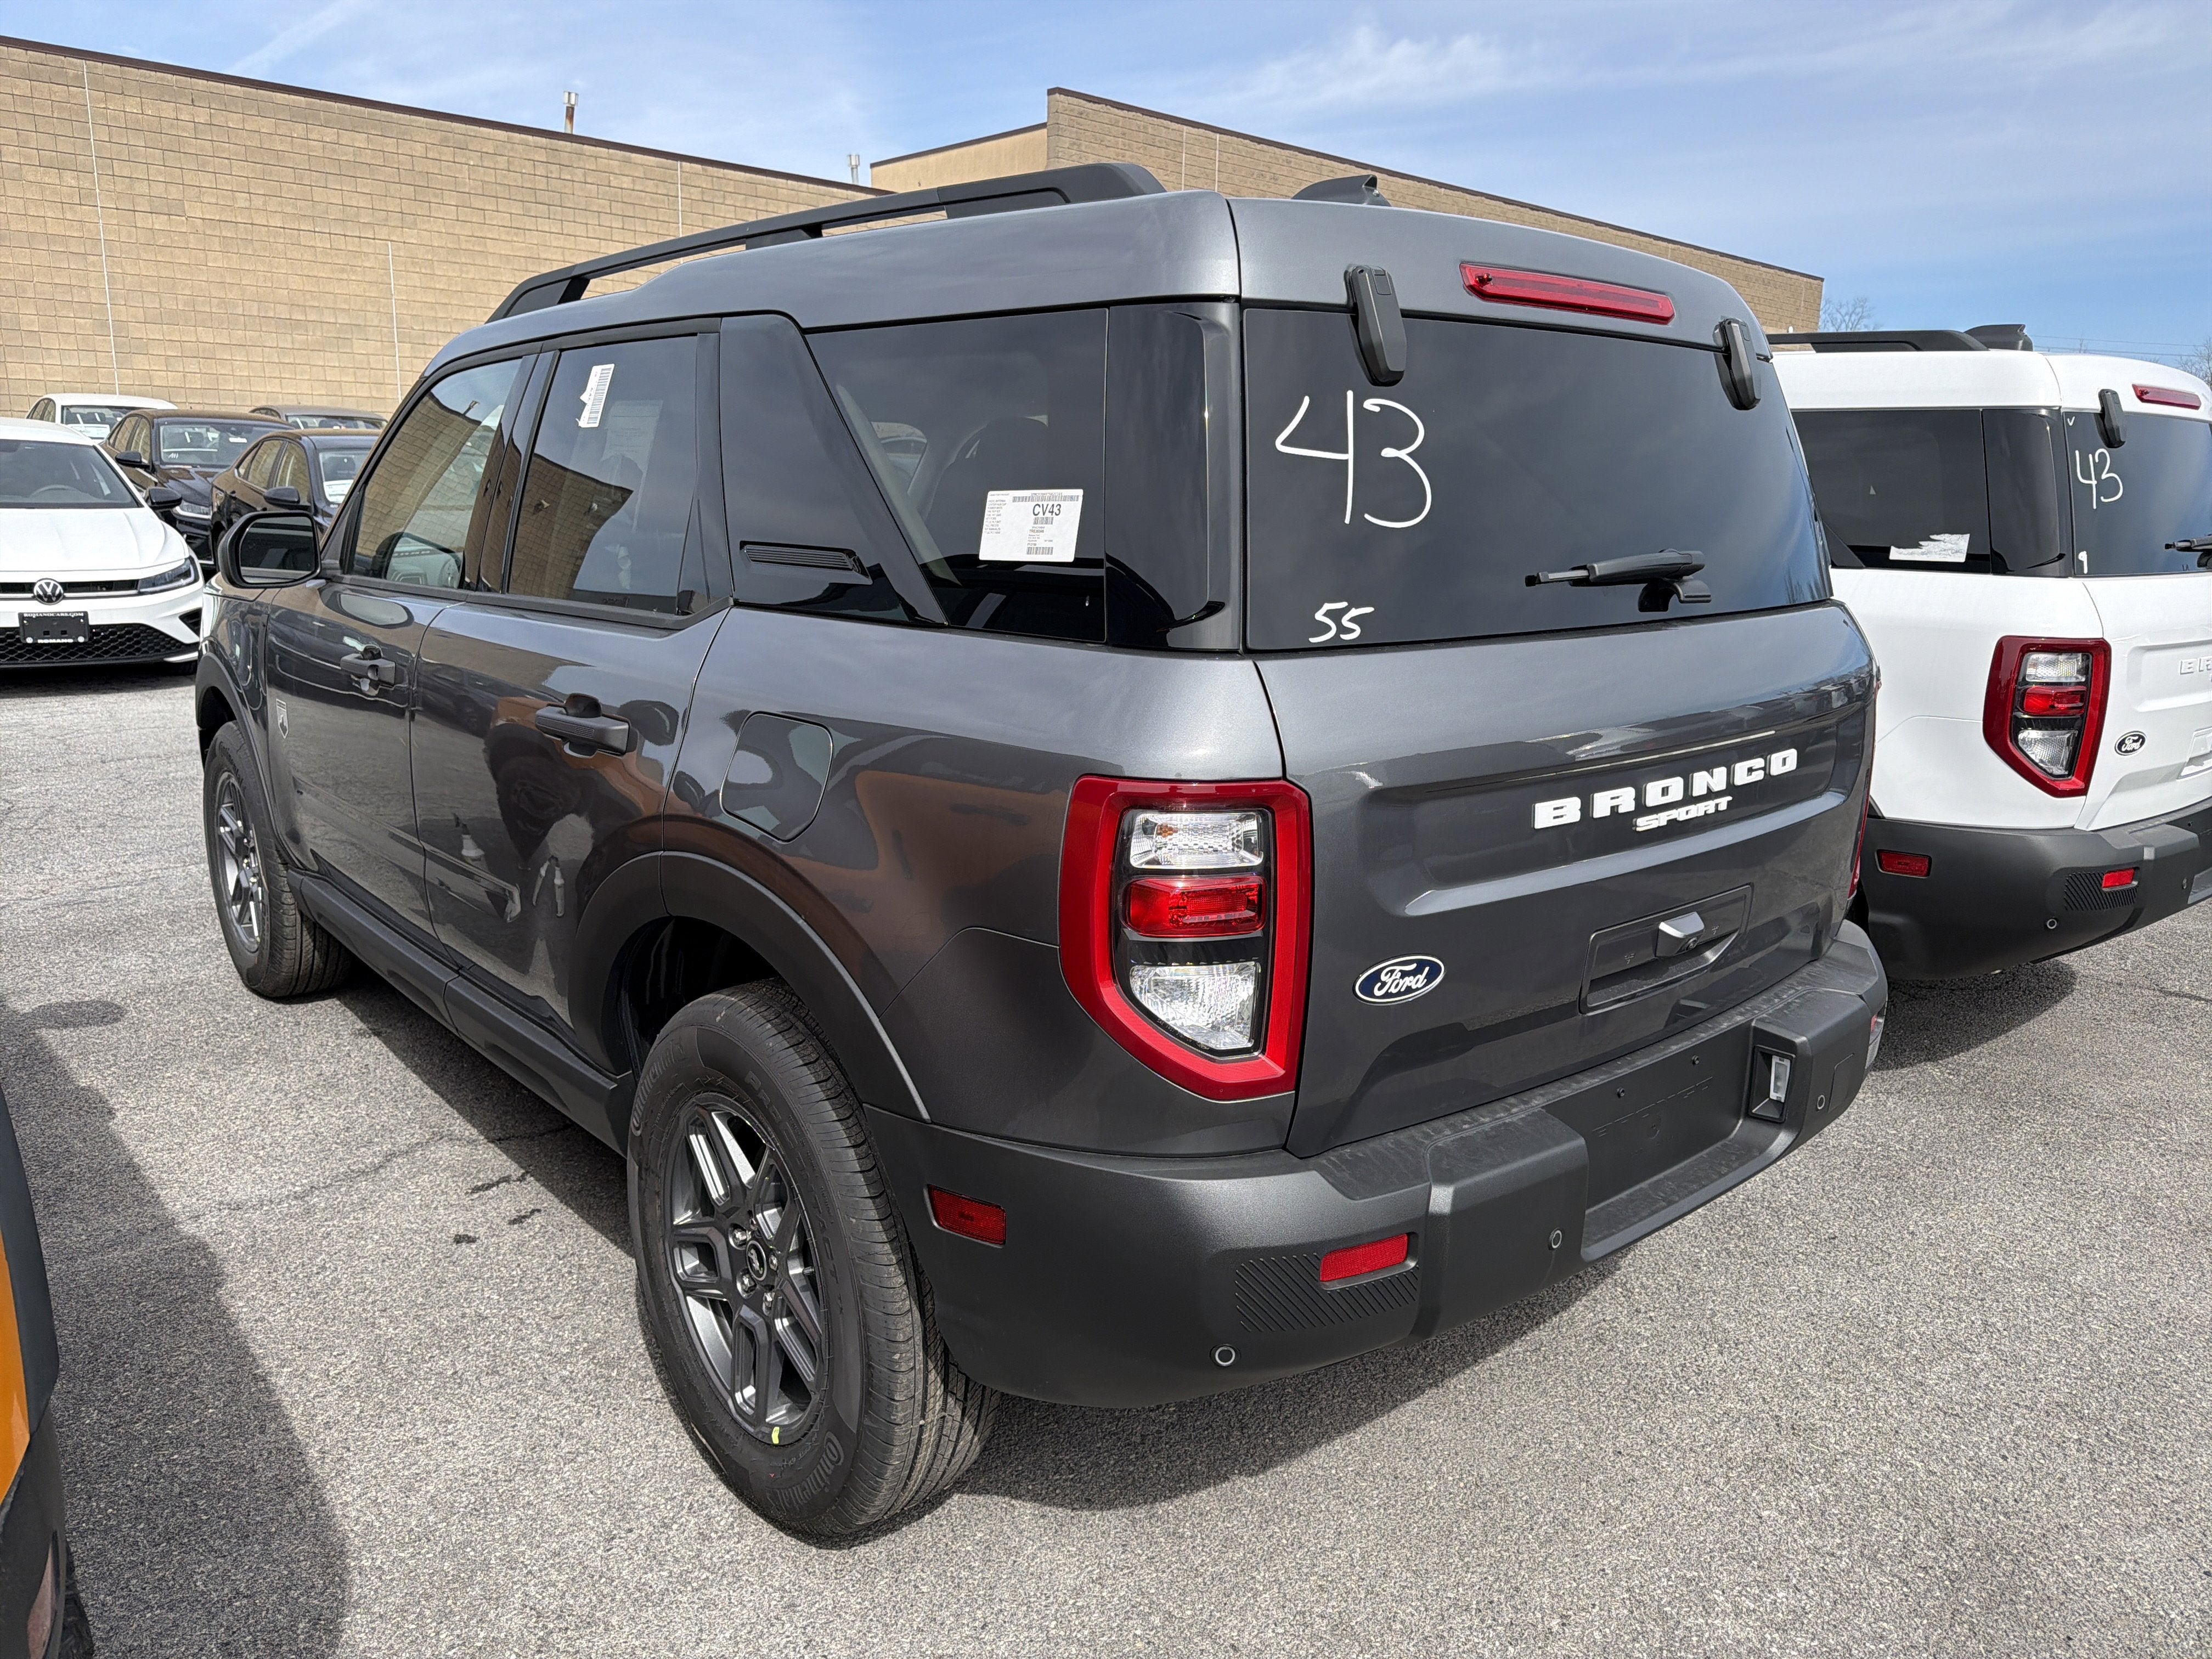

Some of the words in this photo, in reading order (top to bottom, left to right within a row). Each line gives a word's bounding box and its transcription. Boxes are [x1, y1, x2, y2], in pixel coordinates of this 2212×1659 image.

[1276, 390, 1431, 528] 43
[2075, 448, 2123, 509] 43
[1032, 504, 1061, 516] CV43
[1531, 748, 1798, 830] BRONCO
[1632, 796, 1733, 832] SPORT
